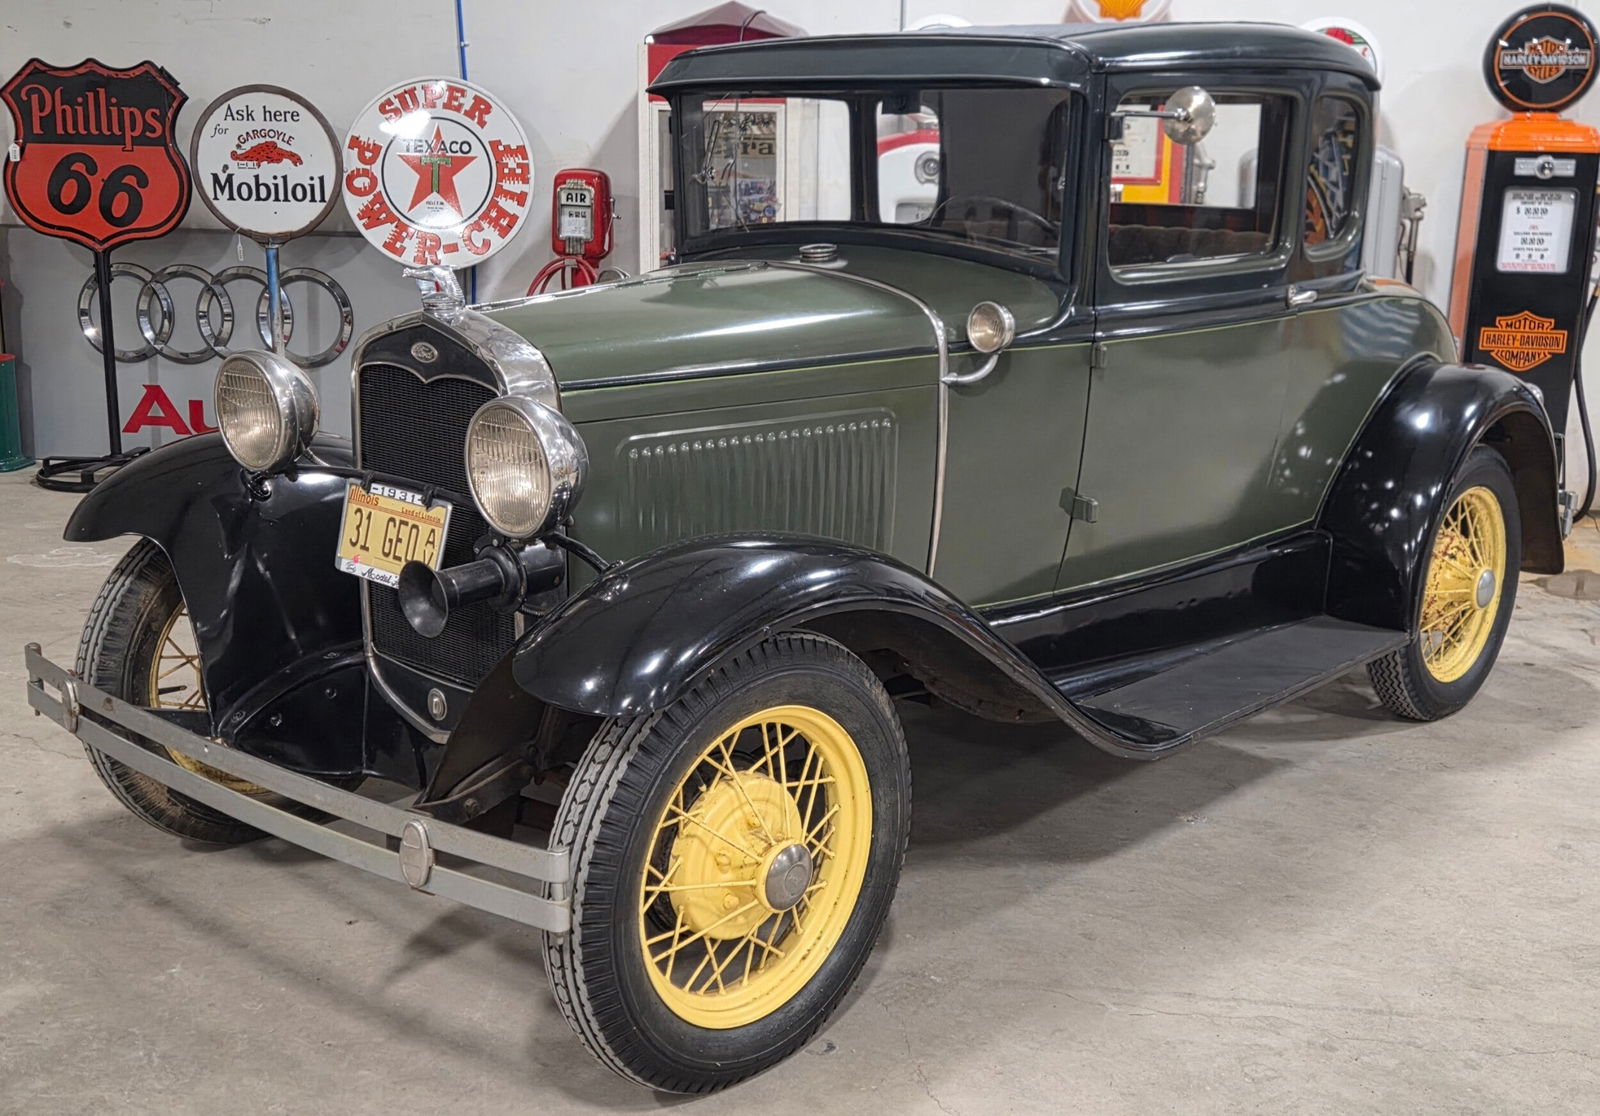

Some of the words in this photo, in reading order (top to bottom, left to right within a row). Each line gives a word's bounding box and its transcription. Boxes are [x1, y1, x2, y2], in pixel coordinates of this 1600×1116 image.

[224, 103, 255, 121] Ask
[262, 104, 300, 122] here
[378, 83, 492, 129] SUPER
[20, 84, 163, 151] Phillips
[210, 123, 229, 139] for
[237, 128, 295, 146] GARGOYLE
[402, 138, 472, 155] TEXACO
[47, 152, 149, 228] 66
[210, 173, 327, 203] Mobiloil
[566, 192, 587, 203] AIR
[1505, 317, 1545, 331] MOTOR
[1485, 333, 1561, 348] HARLEY-DAVIDSON
[1500, 349, 1543, 367] COMPANY
[349, 485, 380, 507] Illinois
[349, 507, 373, 552] 31
